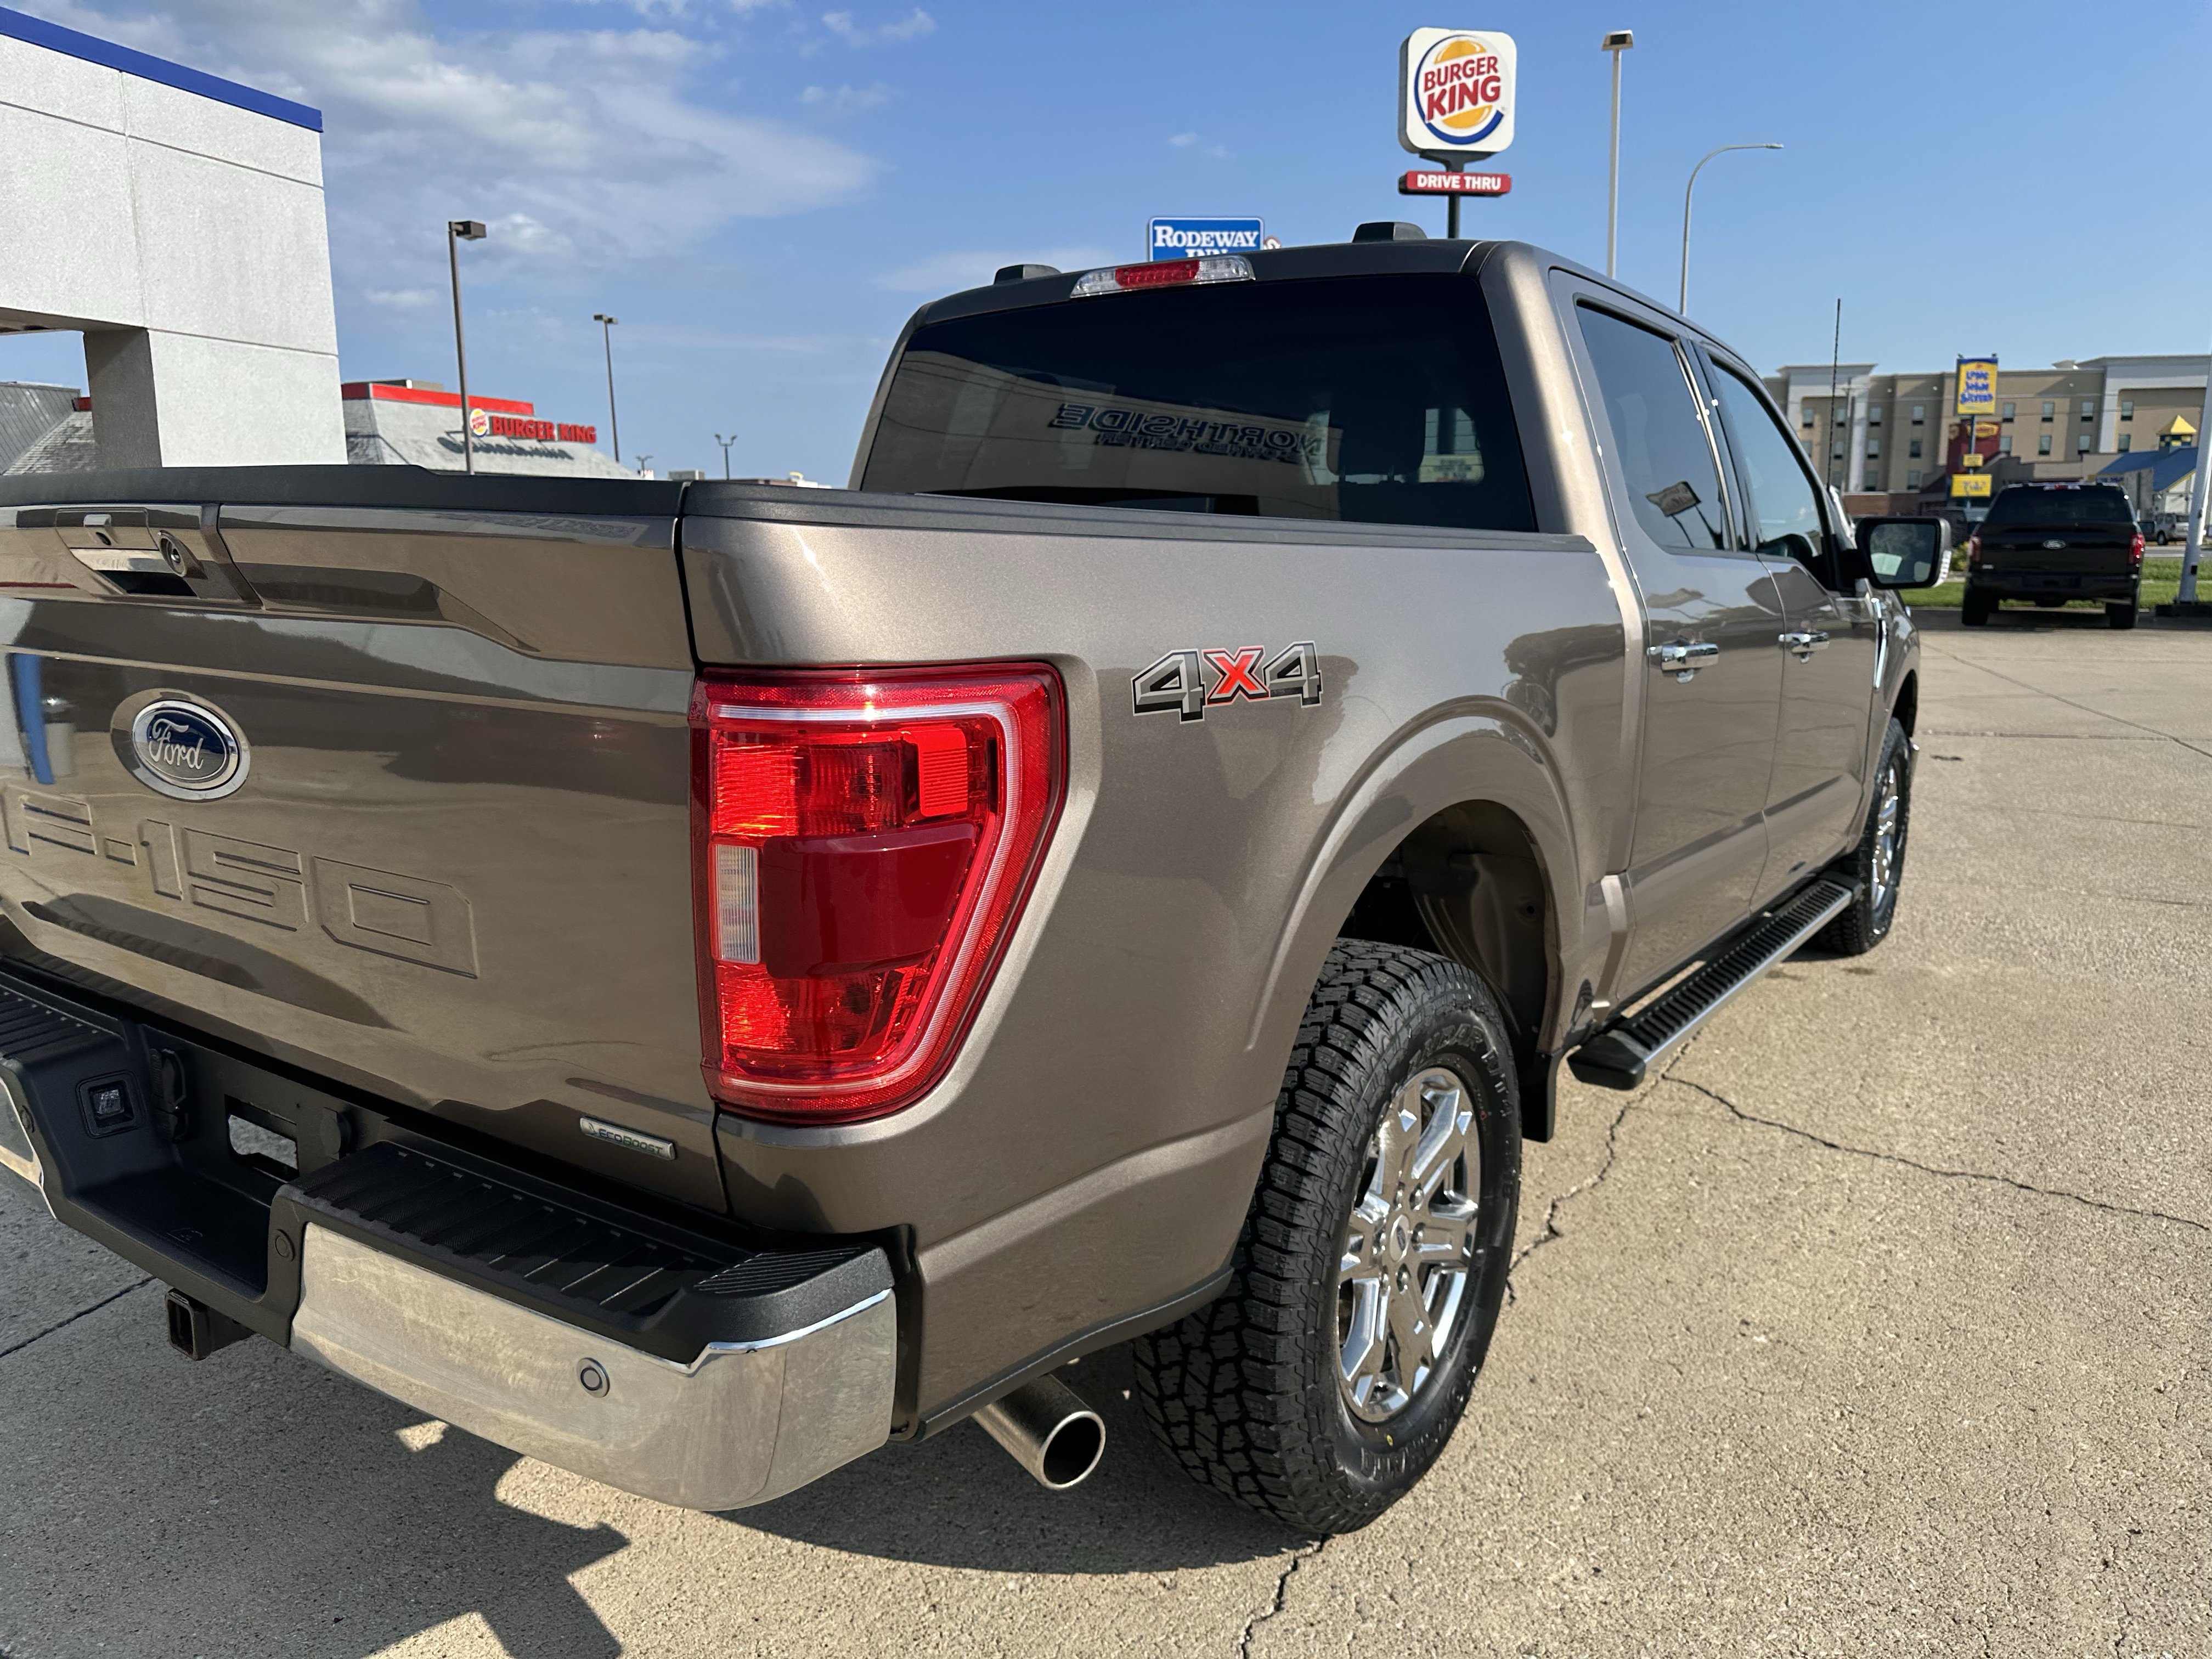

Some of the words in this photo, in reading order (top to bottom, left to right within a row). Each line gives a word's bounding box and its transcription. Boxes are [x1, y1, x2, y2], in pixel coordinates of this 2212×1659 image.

[1424, 55, 1498, 92] BURGER
[1427, 75, 1500, 120] KING
[1417, 174, 1460, 189] DRIVE
[1464, 176, 1501, 190] THRU
[1154, 225, 1259, 247] RODEWAY
[492, 416, 555, 441] BURGER
[558, 423, 597, 444] KING
[146, 718, 204, 770] Ford
[1, 785, 480, 980] F-150
